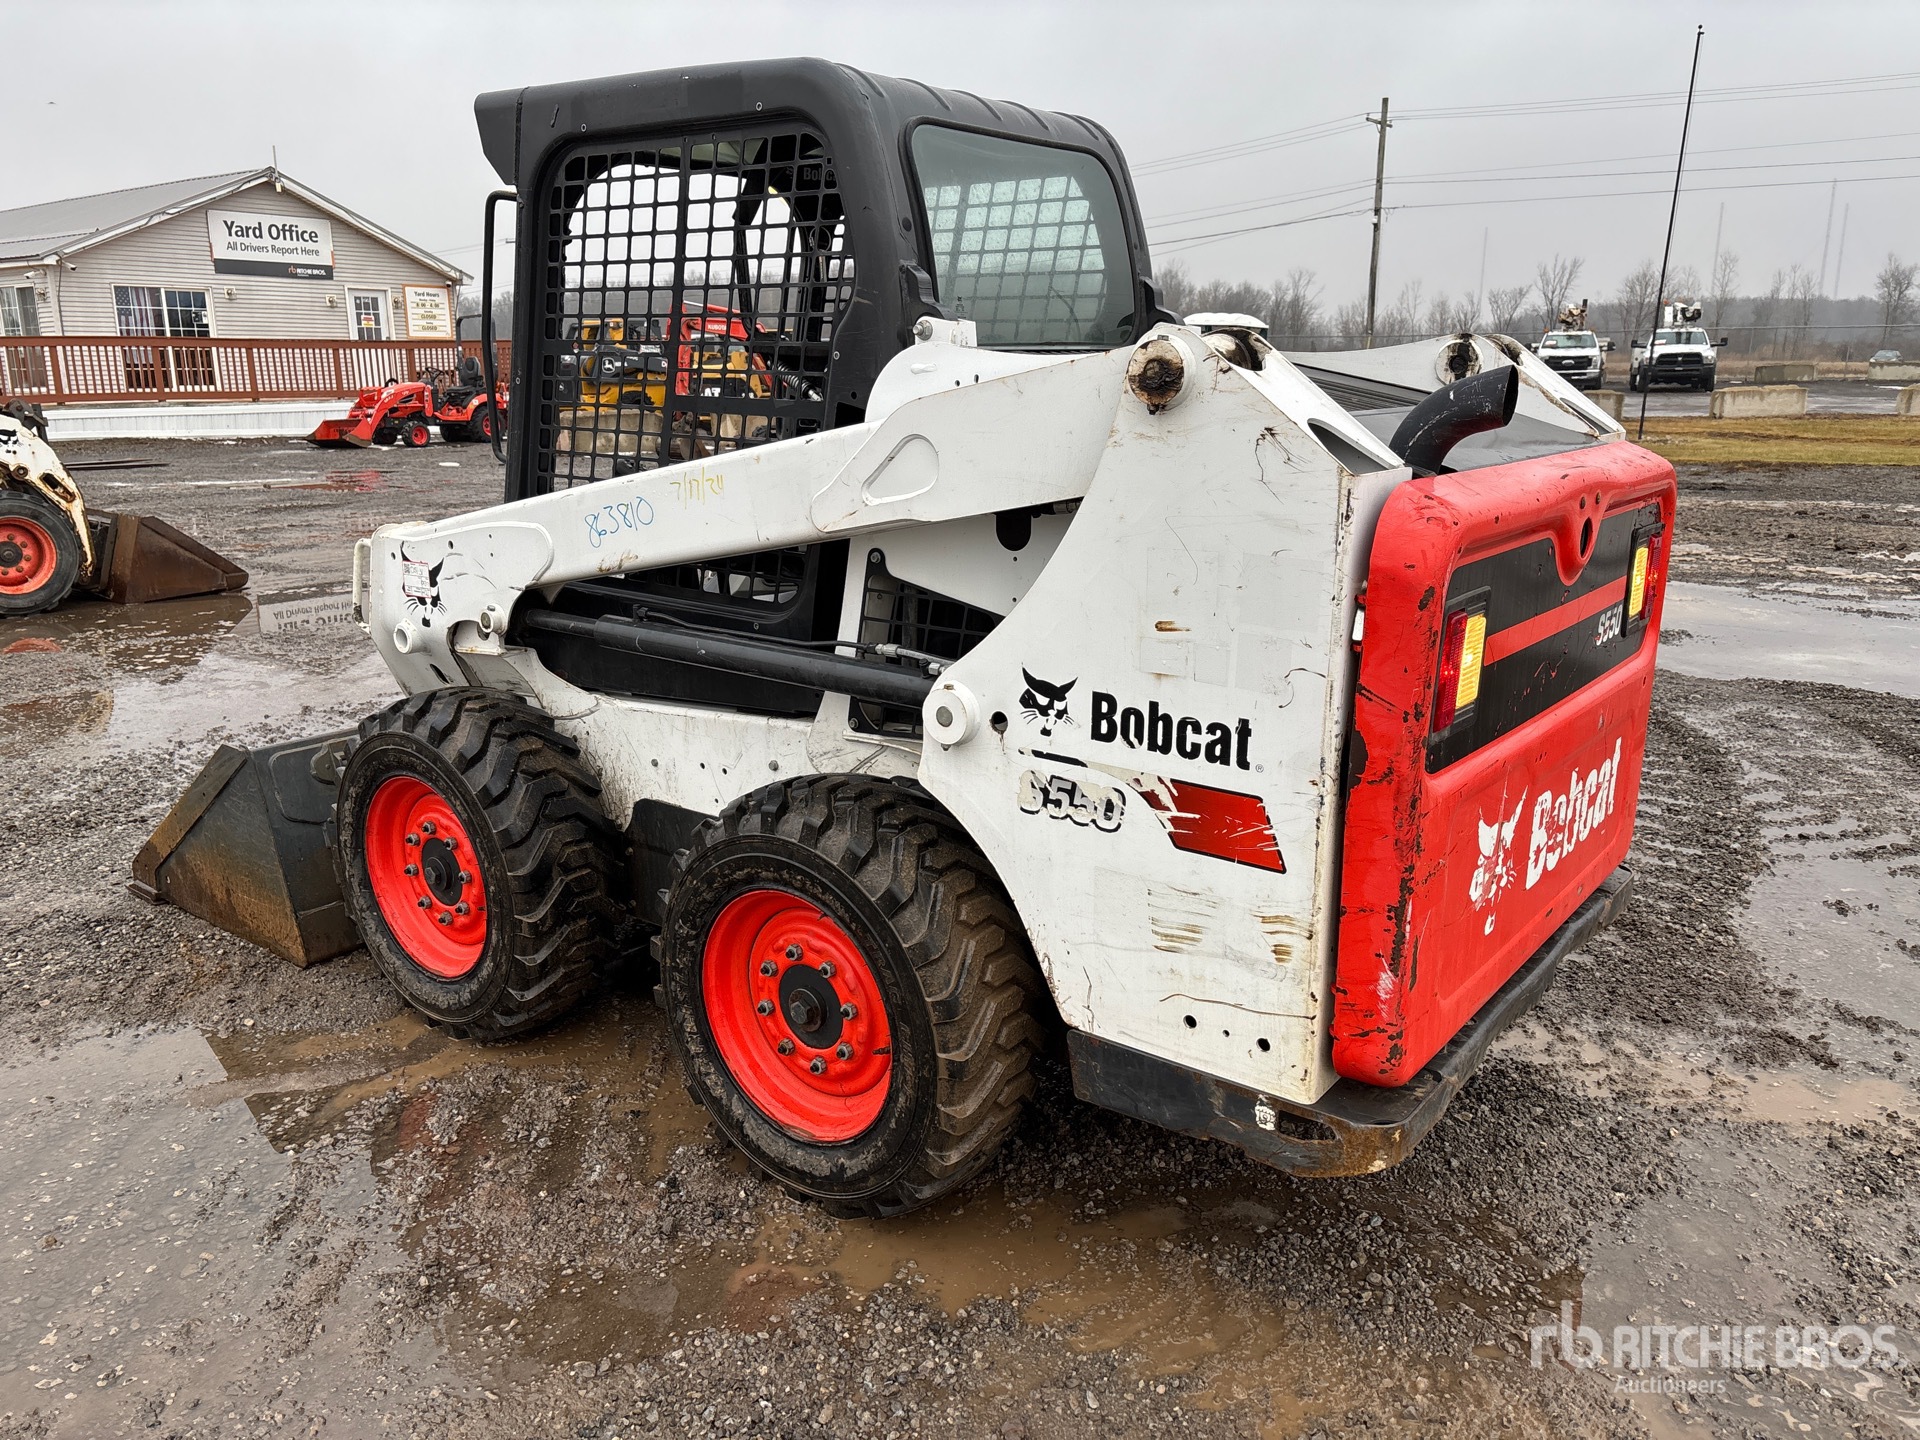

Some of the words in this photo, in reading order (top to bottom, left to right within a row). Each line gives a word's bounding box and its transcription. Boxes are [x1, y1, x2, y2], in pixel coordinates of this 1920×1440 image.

[222, 220, 263, 239] Yard
[268, 223, 318, 243] Office
[226, 241, 238, 251] All
[240, 242, 269, 253] Drivers
[271, 244, 299, 256] Report
[301, 246, 319, 256] Here
[1595, 604, 1623, 646] S550
[1090, 690, 1252, 771] Bobcat
[1525, 736, 1622, 891] Bobcat
